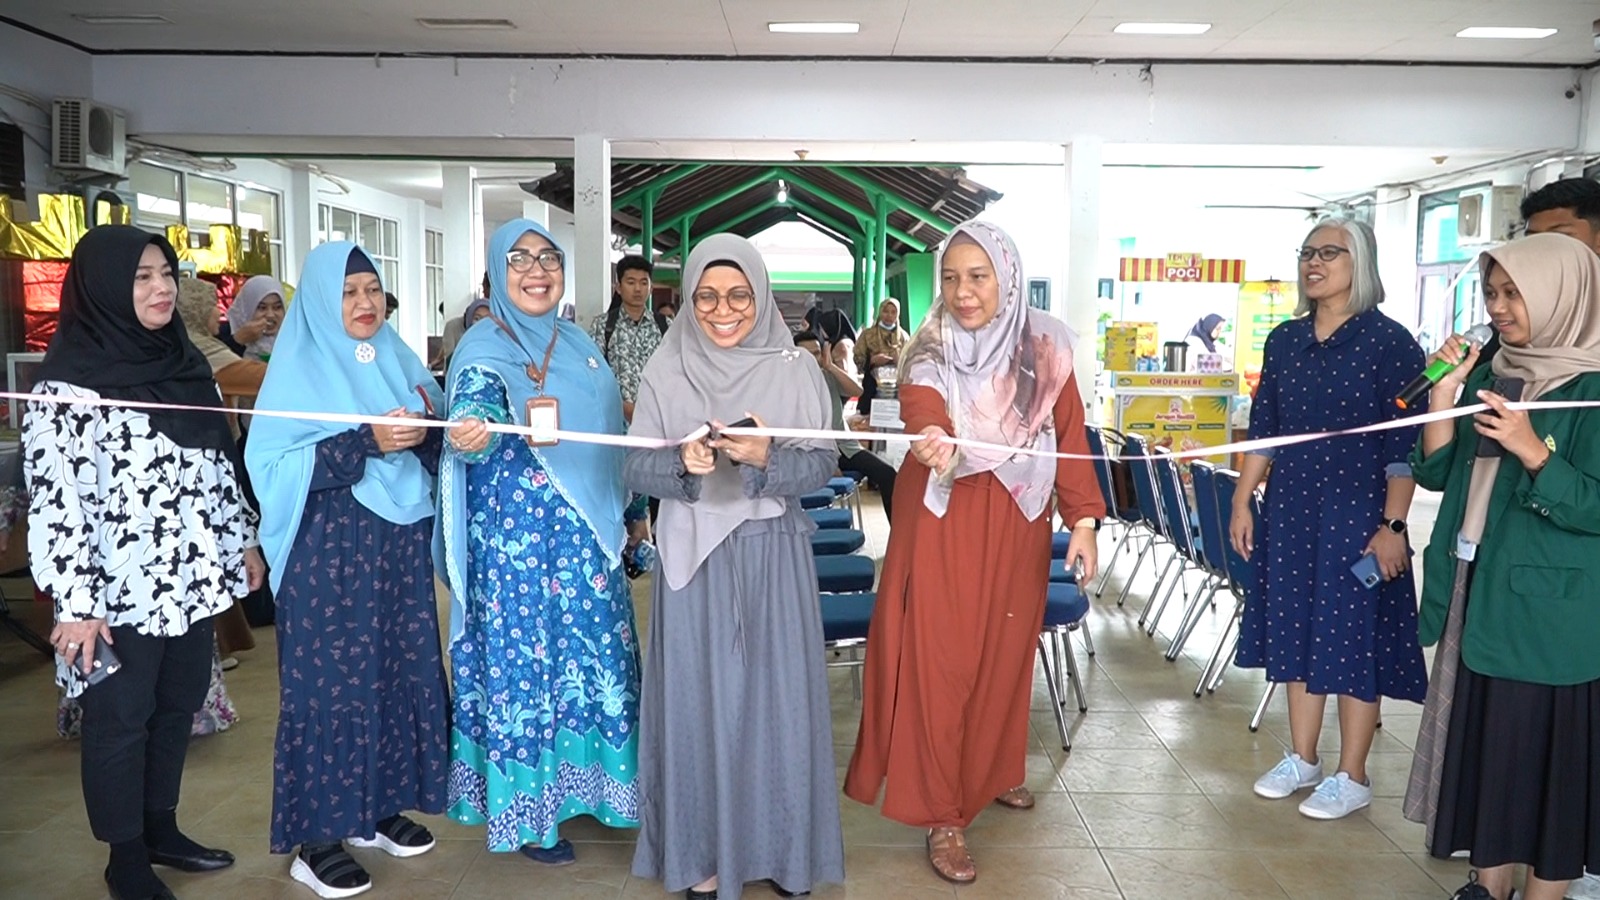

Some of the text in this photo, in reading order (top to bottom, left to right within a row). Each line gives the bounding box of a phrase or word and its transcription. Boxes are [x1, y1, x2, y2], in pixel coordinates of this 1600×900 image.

[1167, 268, 1200, 279] POCI
[1150, 378, 1203, 386] ORDER HERE
